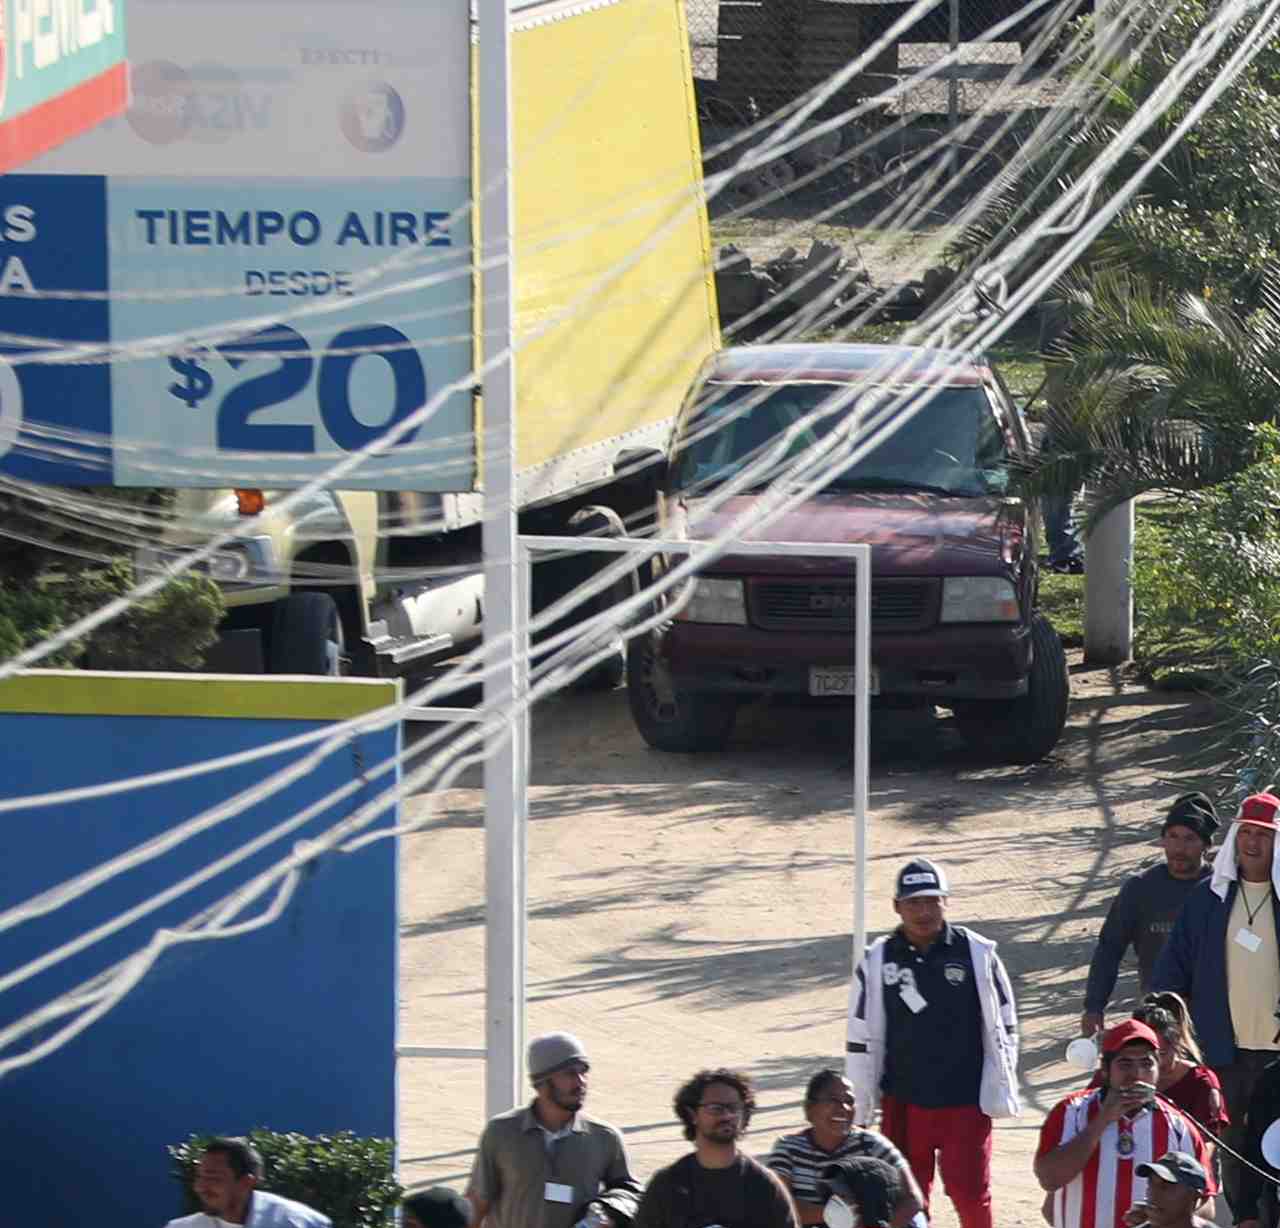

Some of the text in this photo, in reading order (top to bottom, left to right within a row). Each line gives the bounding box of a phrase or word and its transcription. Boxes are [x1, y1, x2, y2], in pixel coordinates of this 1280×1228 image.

[137, 209, 452, 247] TIEMPO AIRE
[244, 270, 354, 297] DESDE
[168, 323, 427, 456] $20
